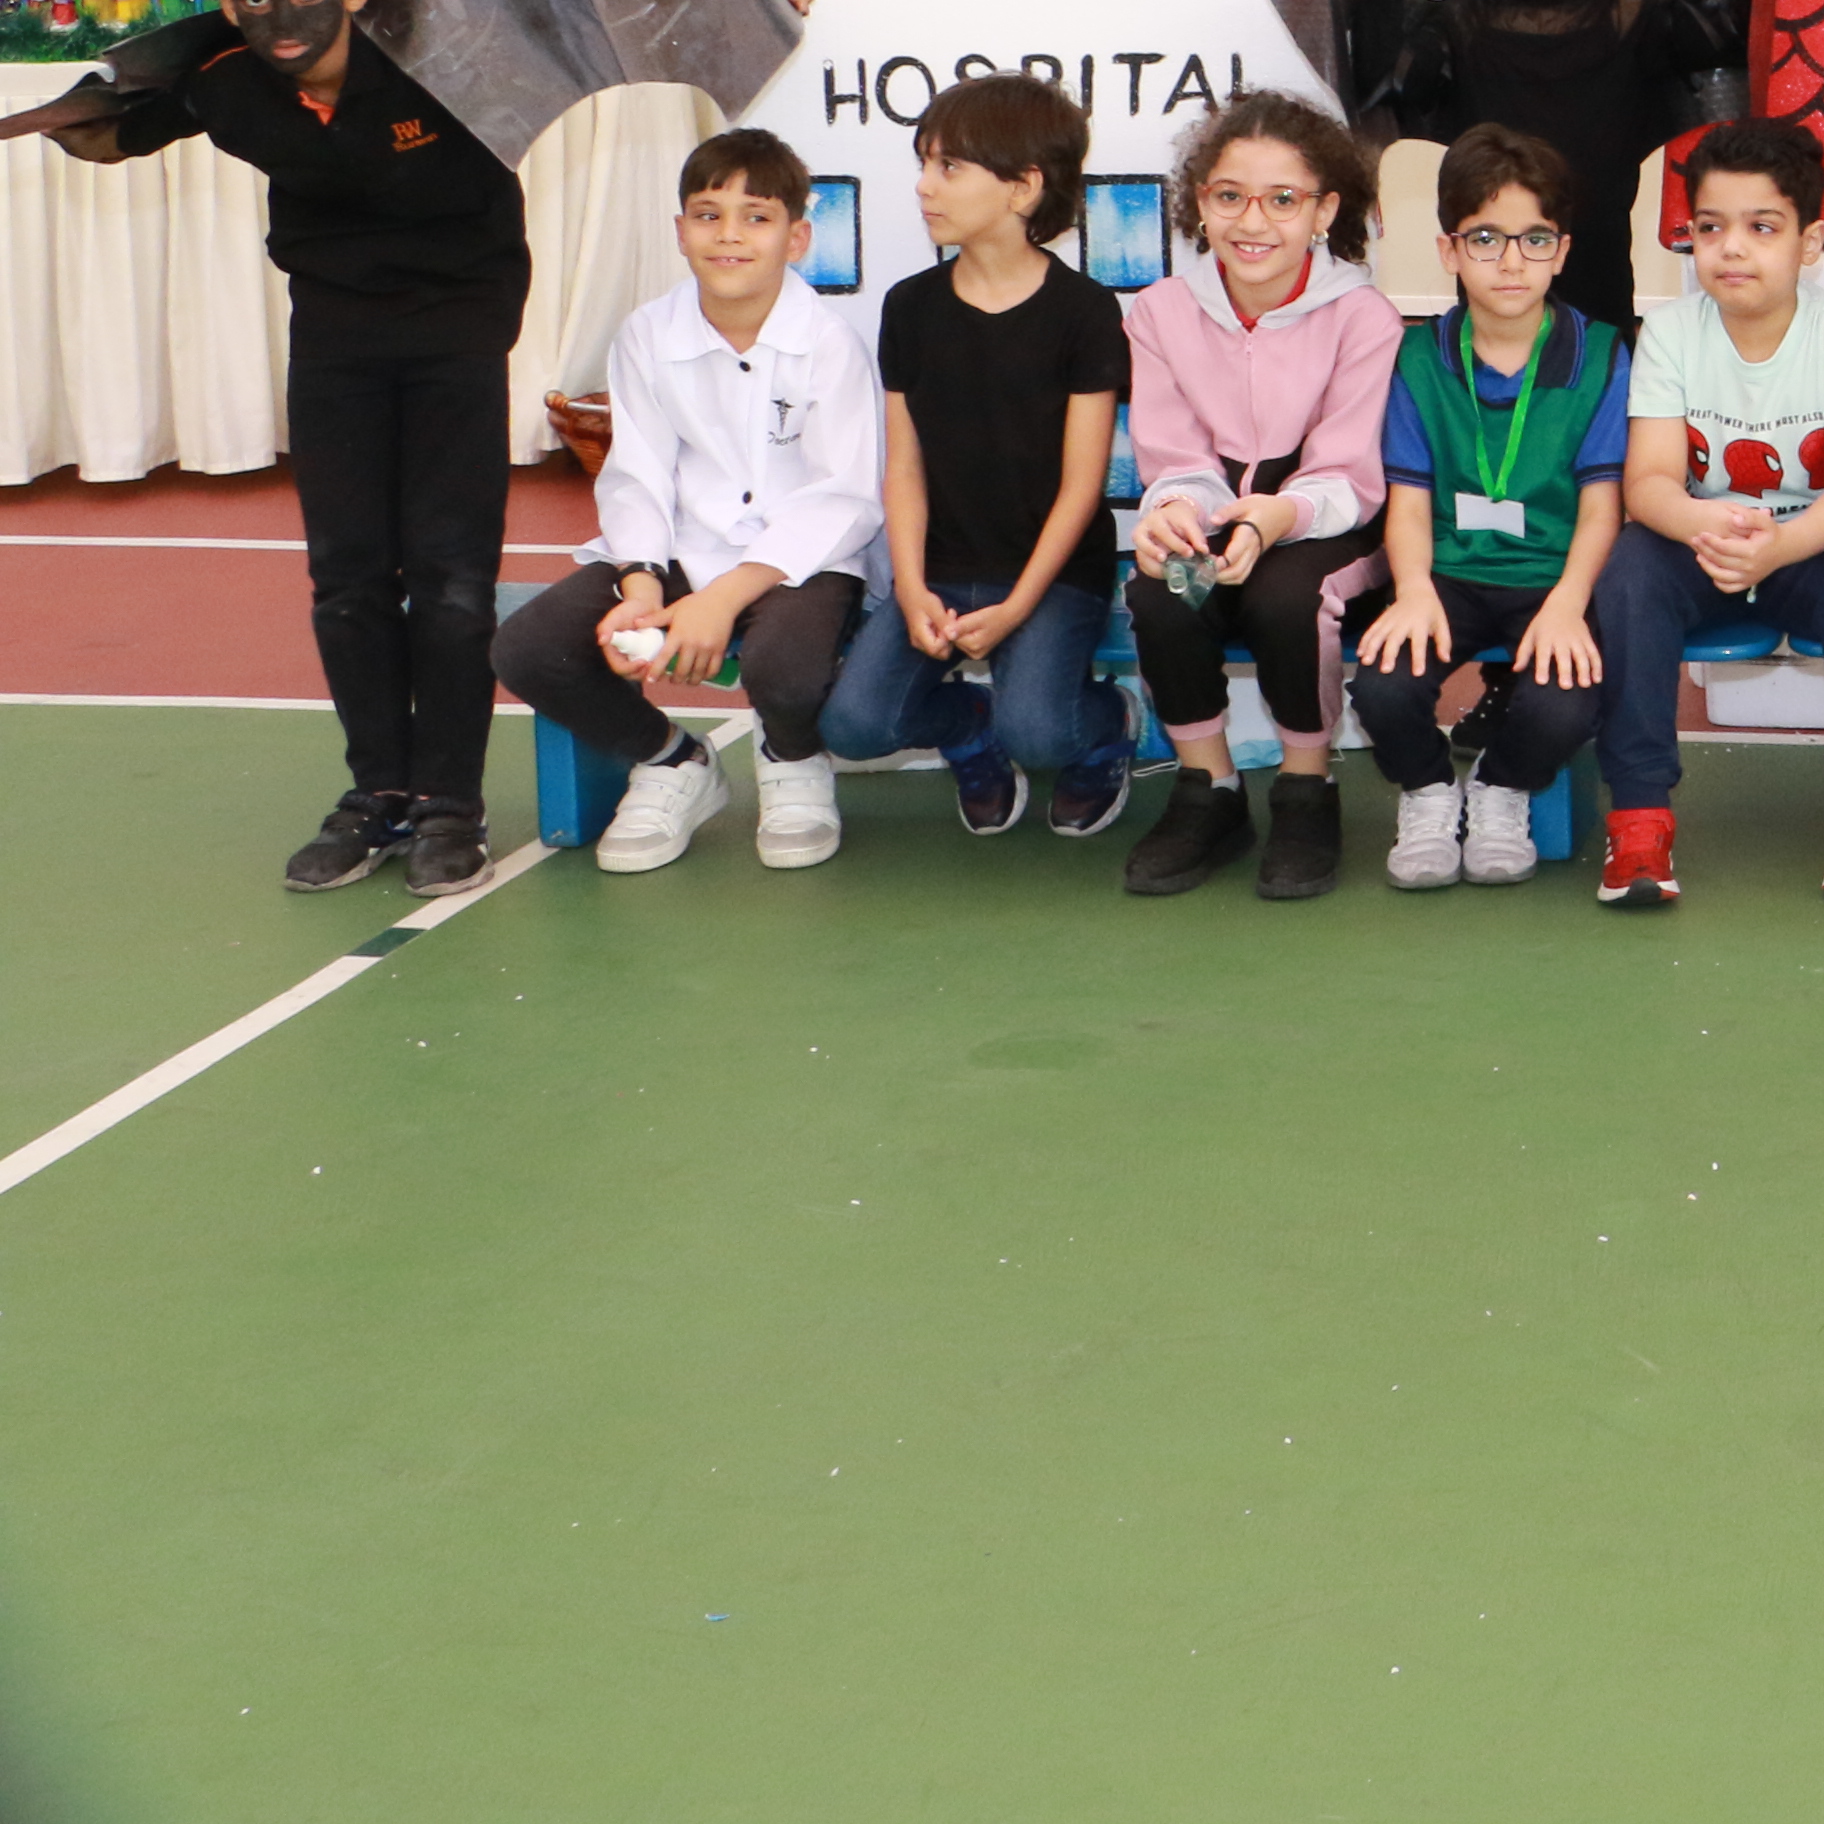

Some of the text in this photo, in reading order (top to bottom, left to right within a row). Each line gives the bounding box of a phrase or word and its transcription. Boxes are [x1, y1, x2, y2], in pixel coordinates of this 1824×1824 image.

[1714, 412, 1743, 429] POWER
[1745, 422, 1772, 432] THERE
[1775, 415, 1800, 429] MUST
